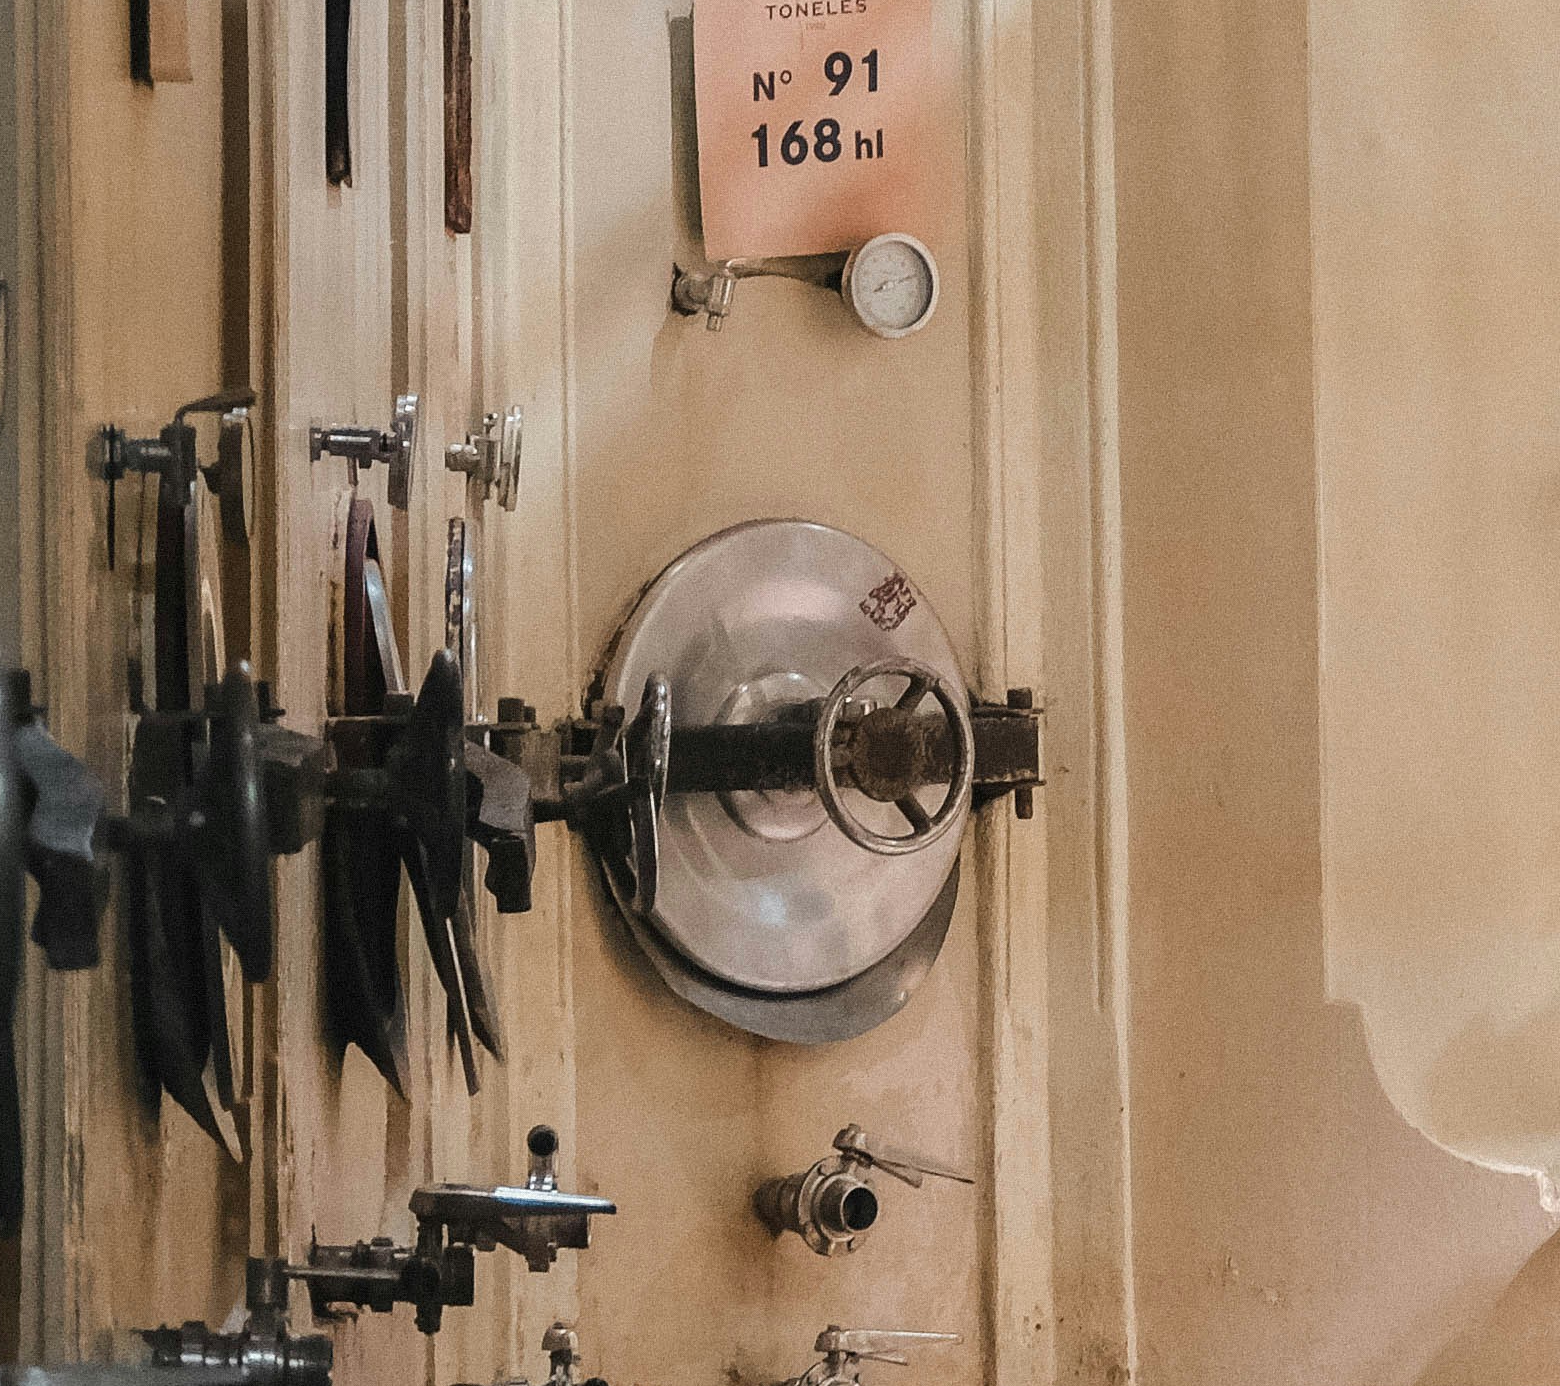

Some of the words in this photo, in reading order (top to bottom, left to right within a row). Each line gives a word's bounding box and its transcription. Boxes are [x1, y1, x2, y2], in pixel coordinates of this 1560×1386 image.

[823, 48, 879, 96] 91
[751, 117, 842, 168] 168
[855, 129, 884, 161] hl
